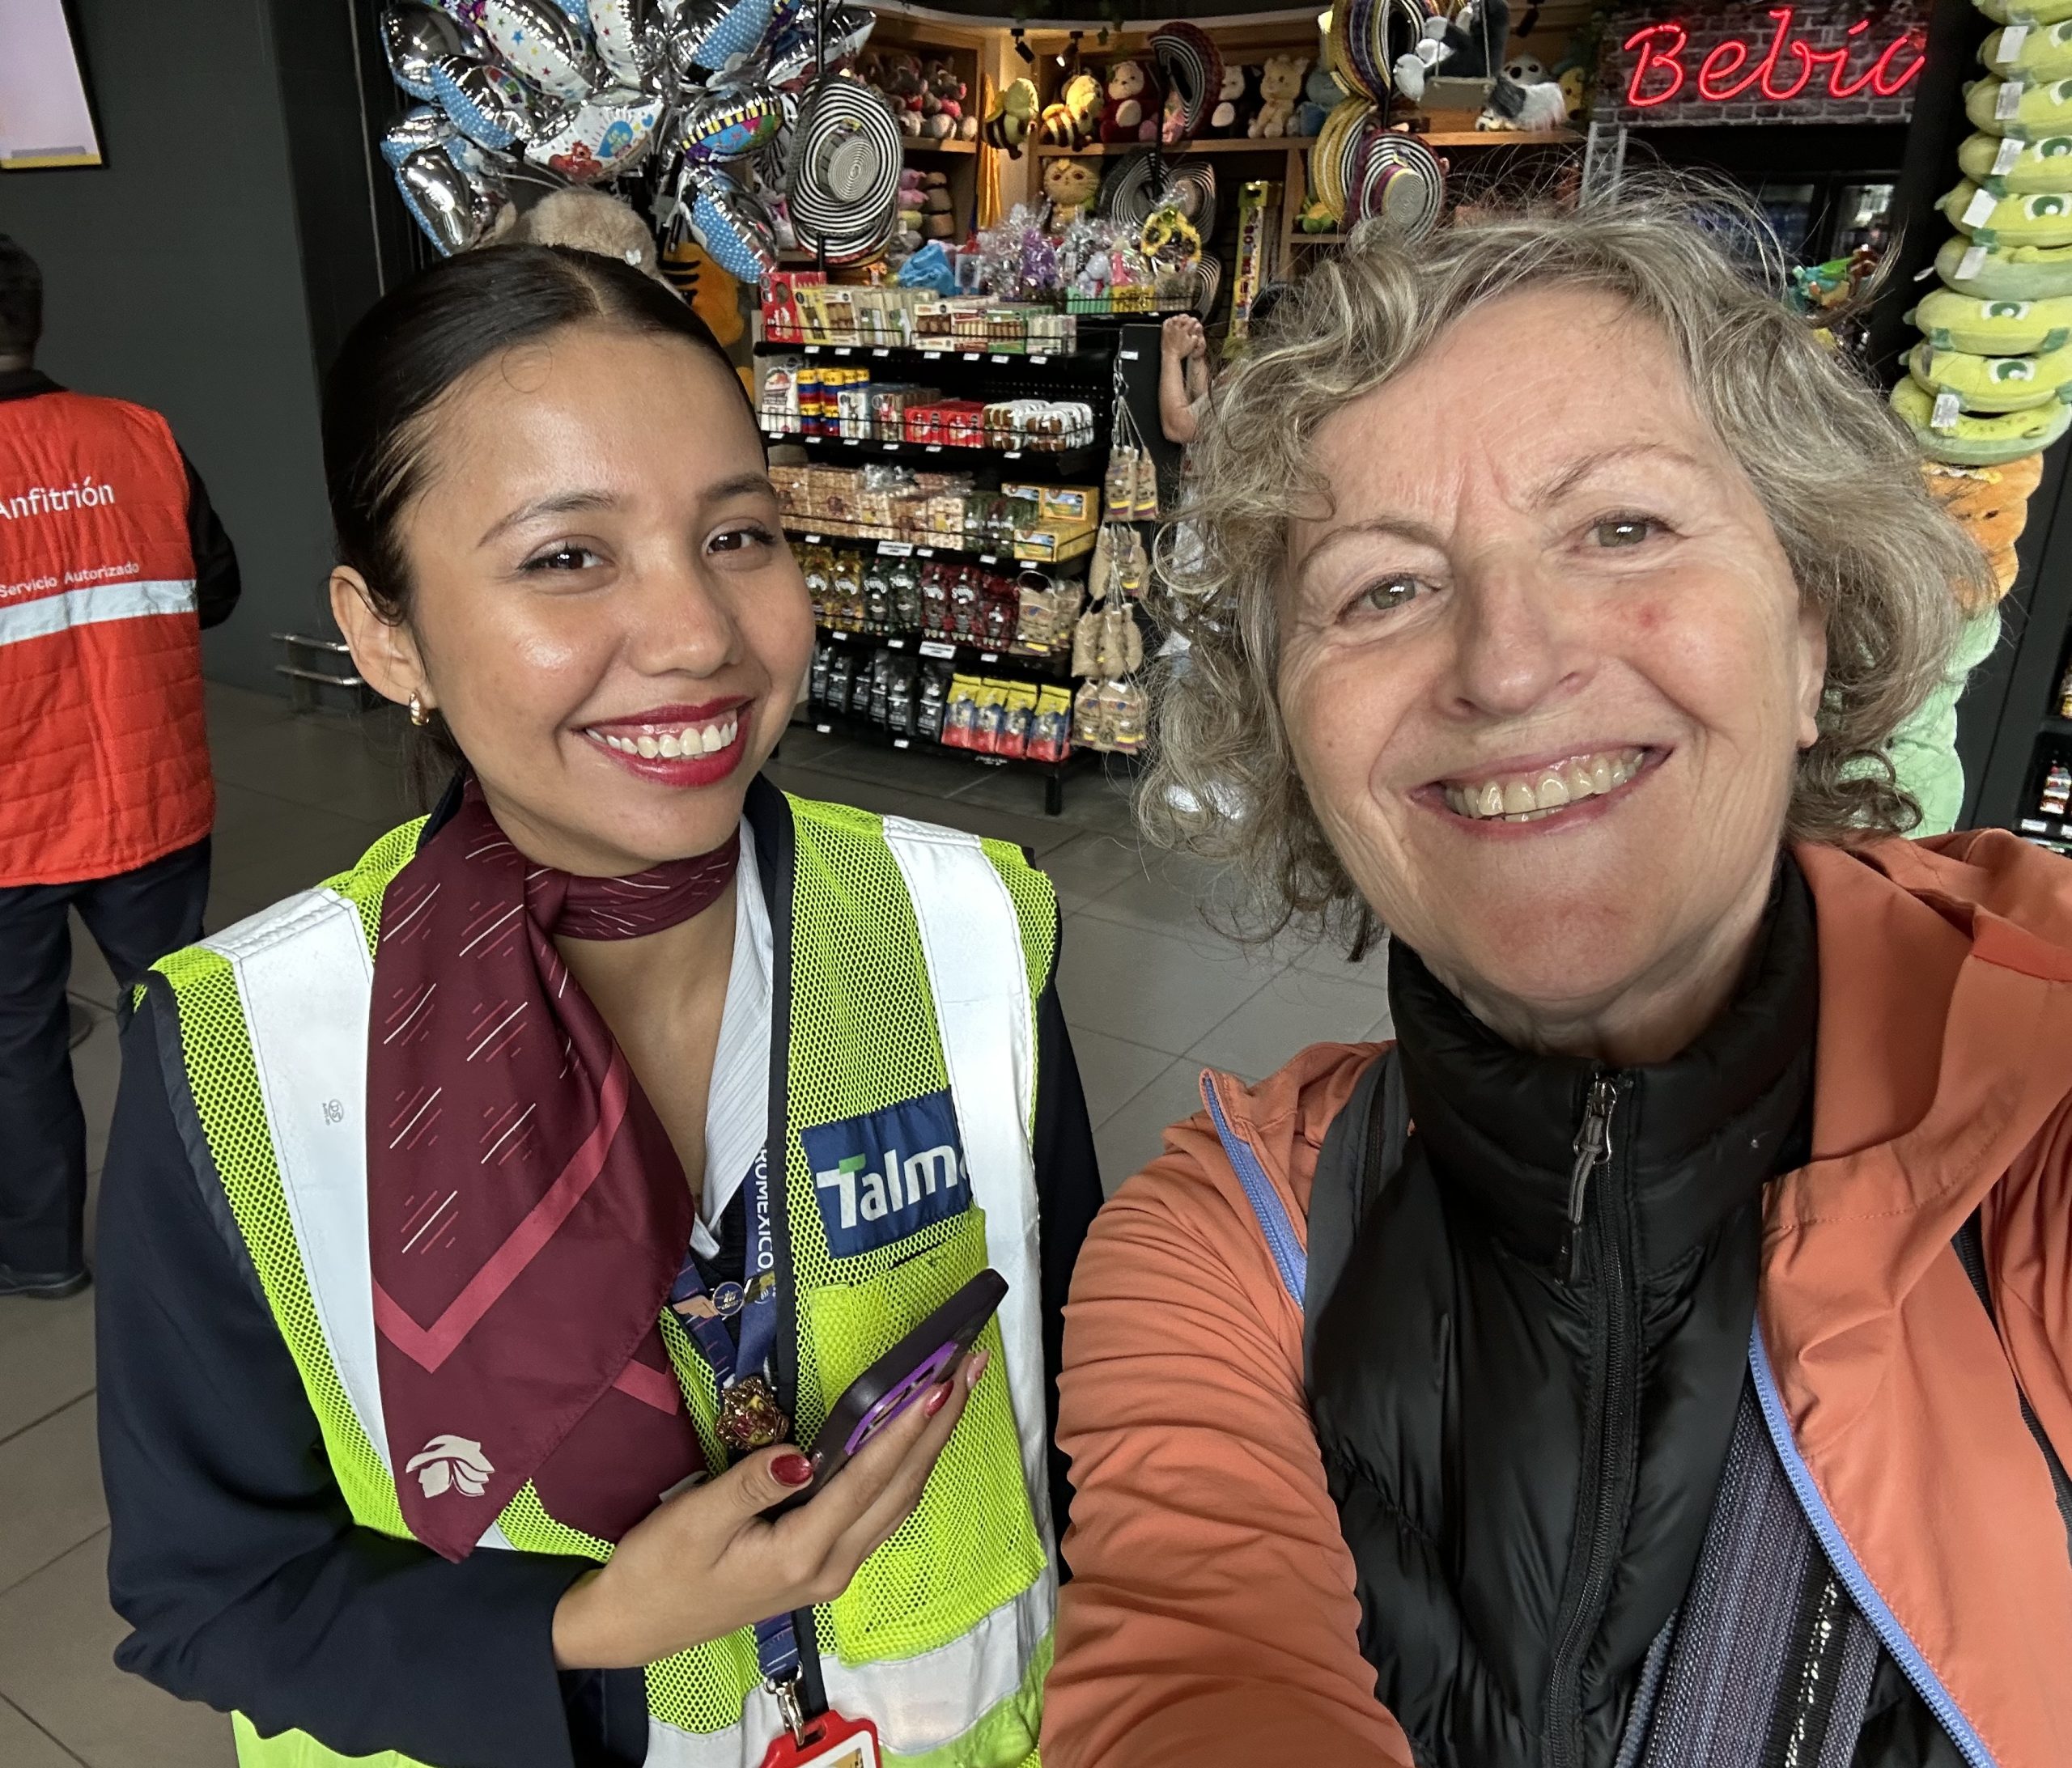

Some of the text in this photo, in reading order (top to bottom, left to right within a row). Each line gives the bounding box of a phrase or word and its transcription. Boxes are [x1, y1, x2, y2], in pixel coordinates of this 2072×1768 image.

[0, 476, 115, 519] Anfitrión
[0, 562, 140, 598] Servicio Autorizado
[816, 1145, 967, 1229] Talm
